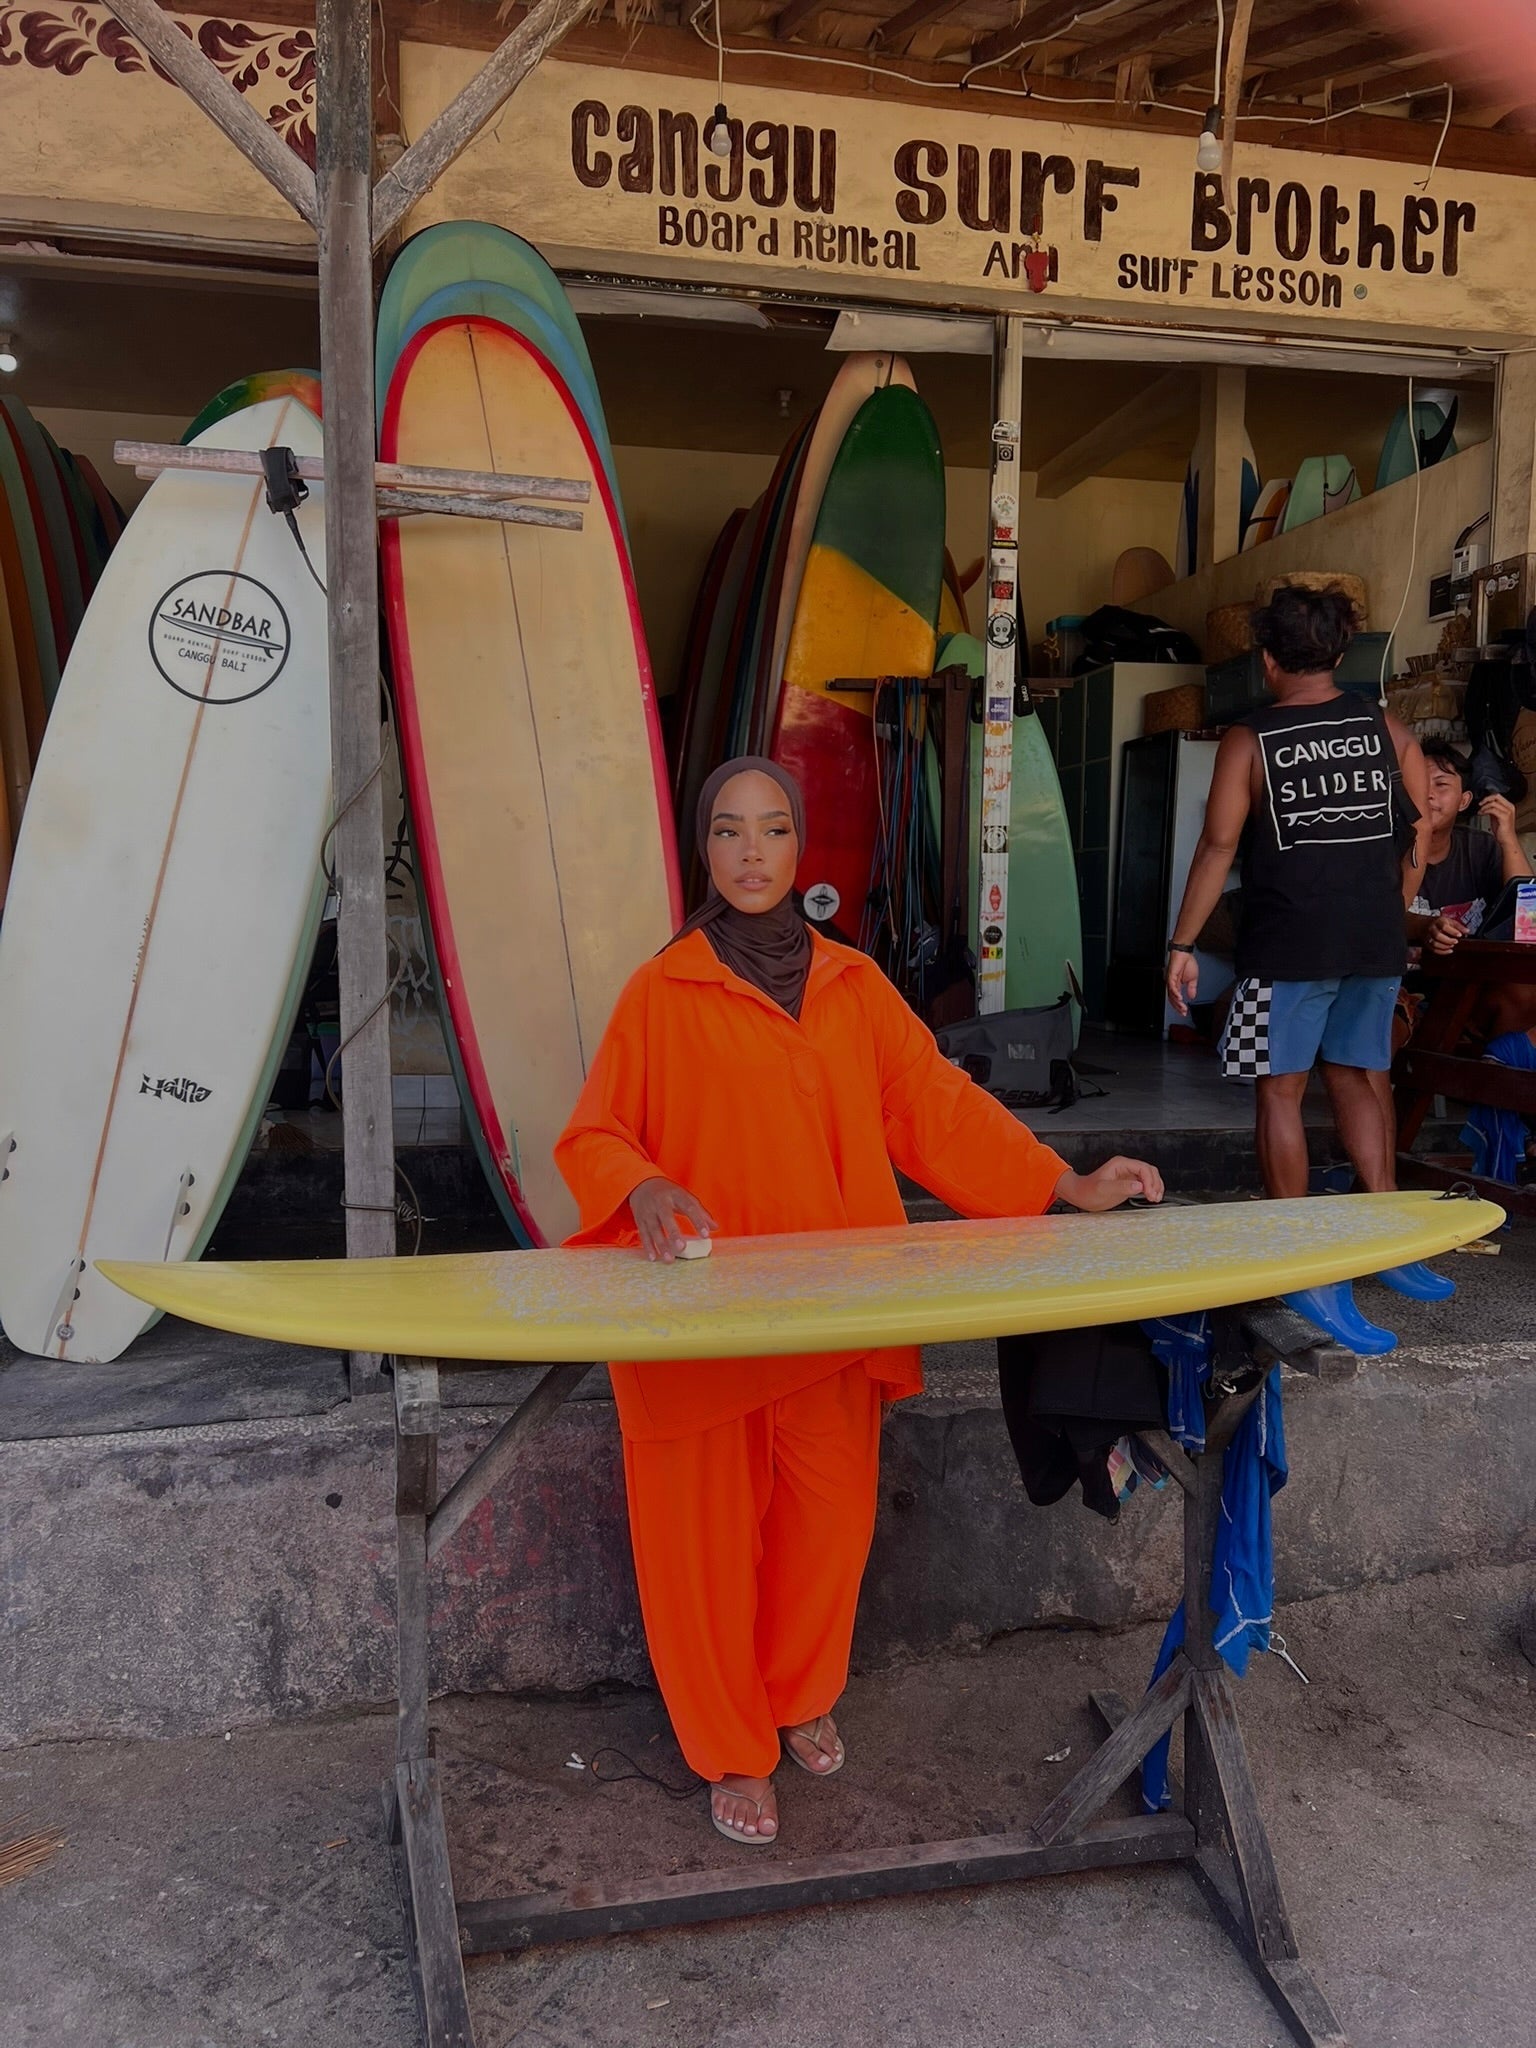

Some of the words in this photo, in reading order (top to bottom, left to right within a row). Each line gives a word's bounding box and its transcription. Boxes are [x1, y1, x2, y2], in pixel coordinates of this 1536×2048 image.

[1191, 171, 1477, 276] Brother
[658, 206, 777, 256] Board
[794, 220, 920, 270] Rental
[1212, 262, 1342, 308] Lesson
[172, 598, 272, 639] SANDBAR
[178, 648, 216, 665] CANGGU
[221, 658, 247, 673] BALI
[1274, 734, 1382, 768] CANGGU
[1280, 769, 1387, 803] SLIDER
